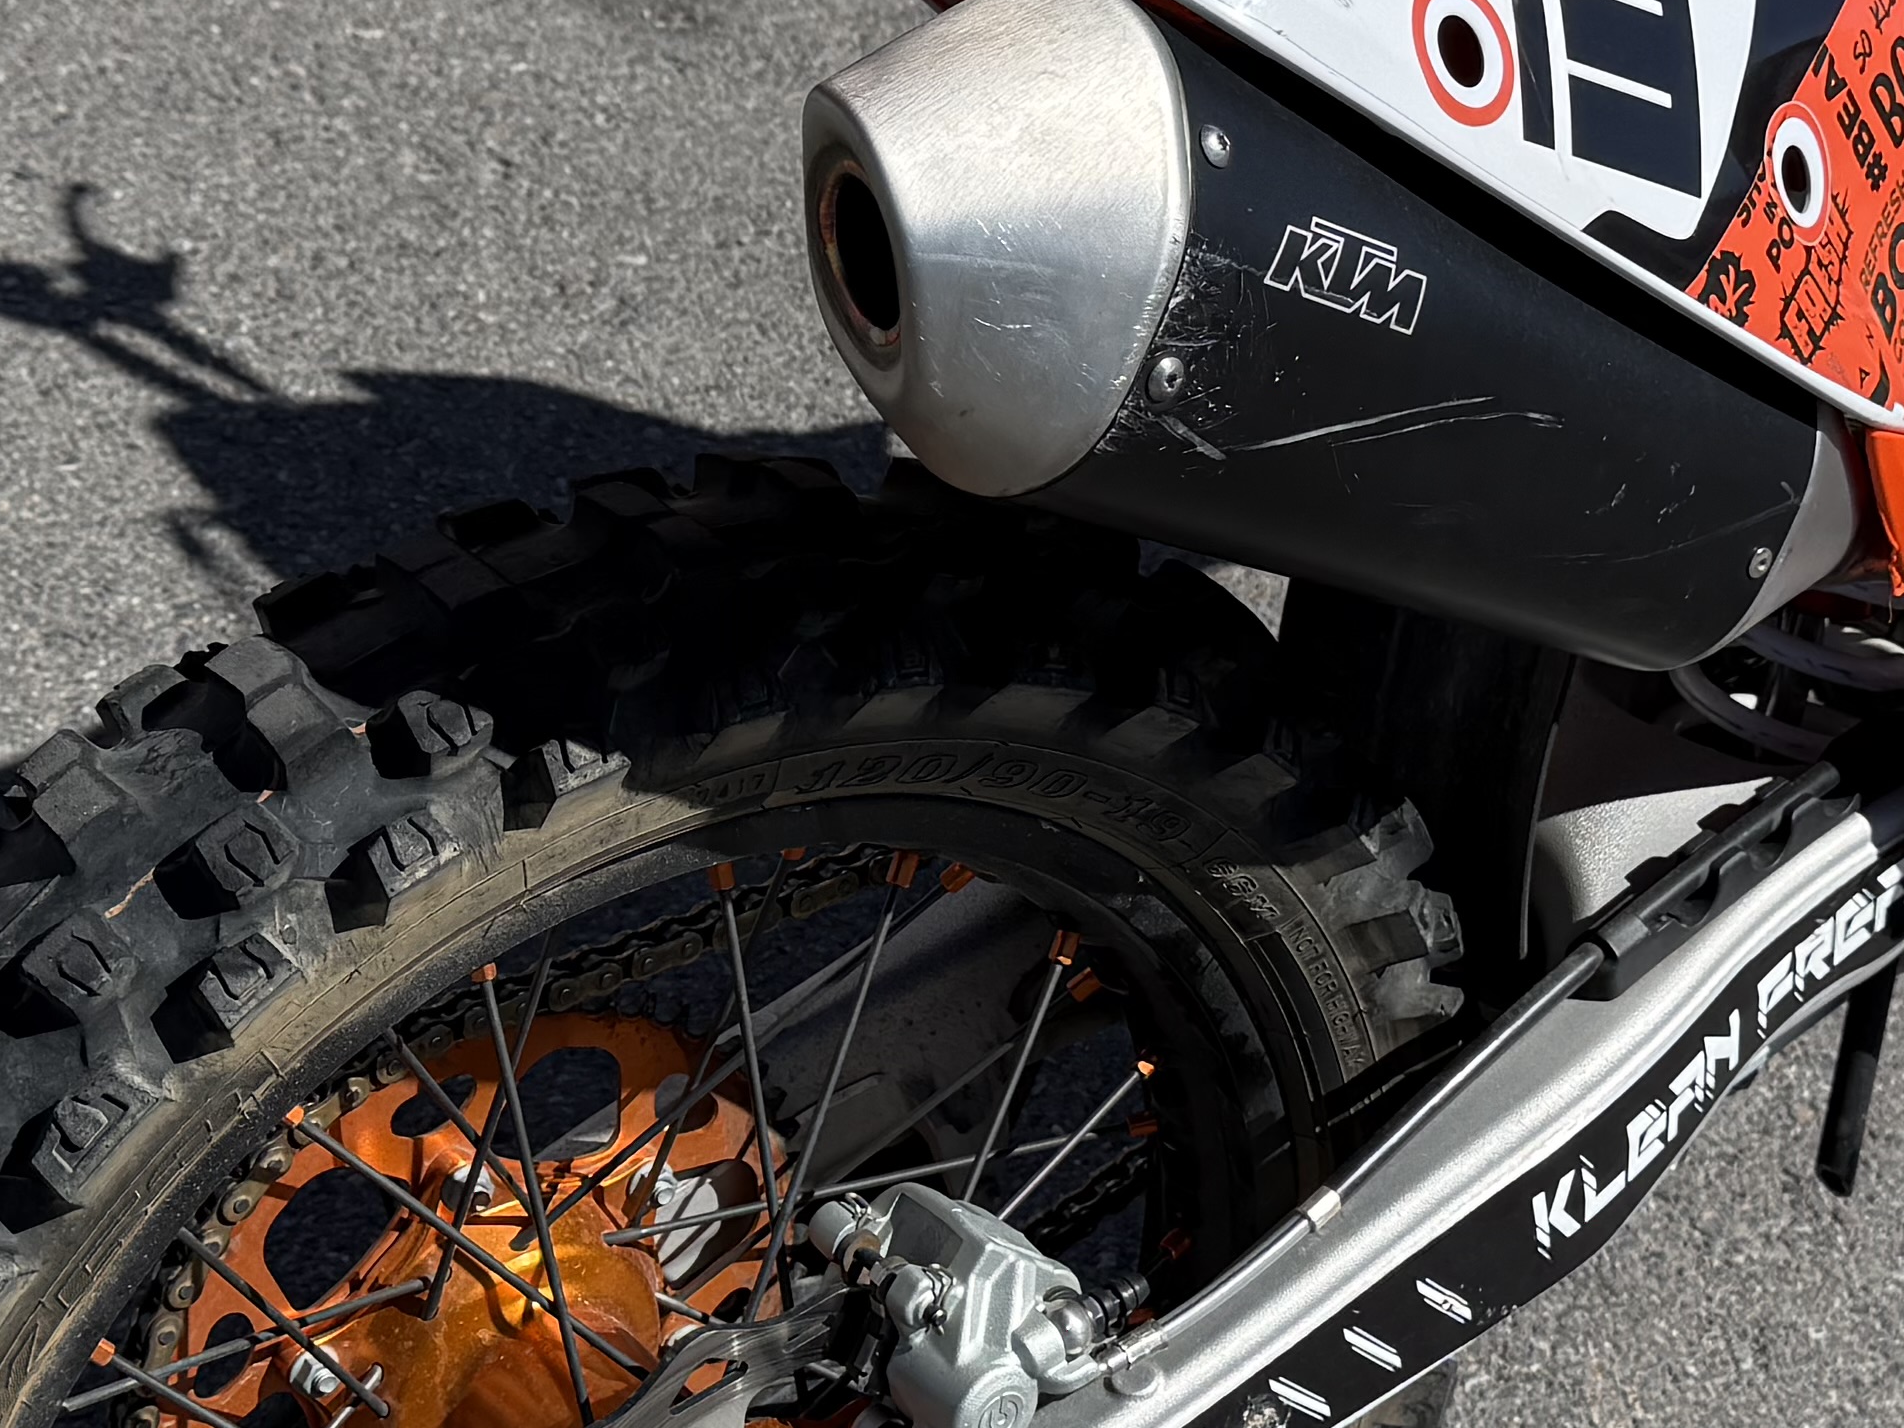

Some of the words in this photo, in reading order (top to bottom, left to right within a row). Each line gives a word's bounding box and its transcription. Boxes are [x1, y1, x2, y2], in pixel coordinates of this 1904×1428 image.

[1853, 29, 1873, 74] SO
[1263, 216, 1428, 336] KTM
[1532, 1008, 1741, 1260] KLEAN
